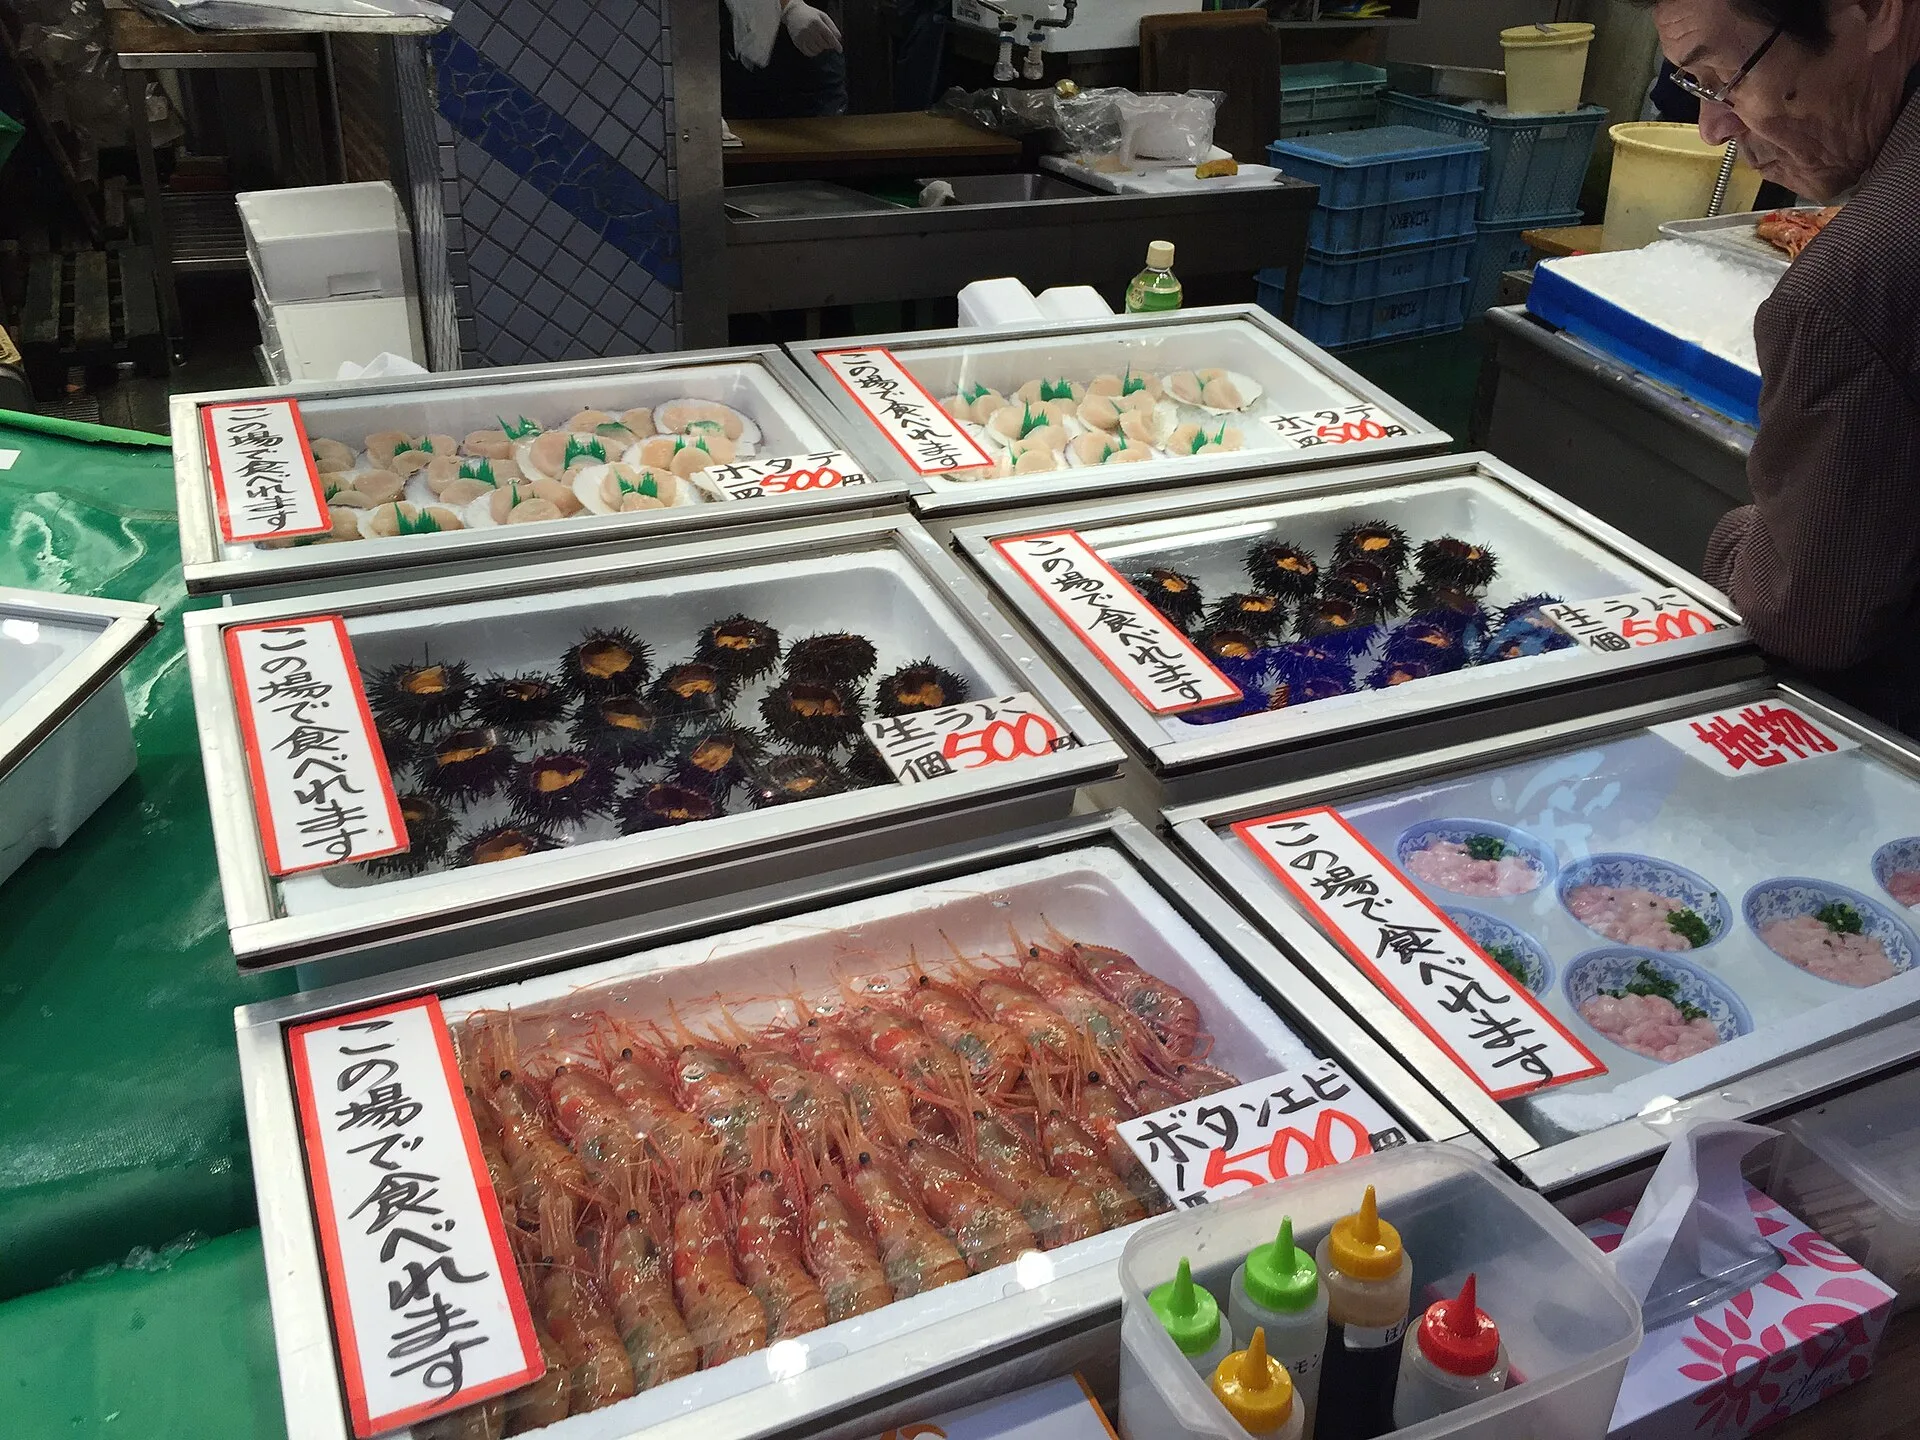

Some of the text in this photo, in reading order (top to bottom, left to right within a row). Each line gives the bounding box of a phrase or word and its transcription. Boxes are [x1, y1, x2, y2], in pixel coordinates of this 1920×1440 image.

[840, 353, 962, 469] この場で食べれます
[1269, 404, 1375, 431] ホタテ
[227, 407, 298, 533] この場で食べれます
[712, 451, 842, 482] ホタテ
[1024, 540, 1204, 704] この場で食べれます
[1550, 594, 1689, 629] 生うに
[256, 627, 368, 864] この場で食べれます
[872, 696, 1028, 748] 生うに
[1689, 705, 1839, 770] 地物
[1267, 821, 1554, 1089] この場で食べれます
[1135, 1061, 1352, 1163] ボタンエビ
[336, 1020, 490, 1409] この場で食べれます
